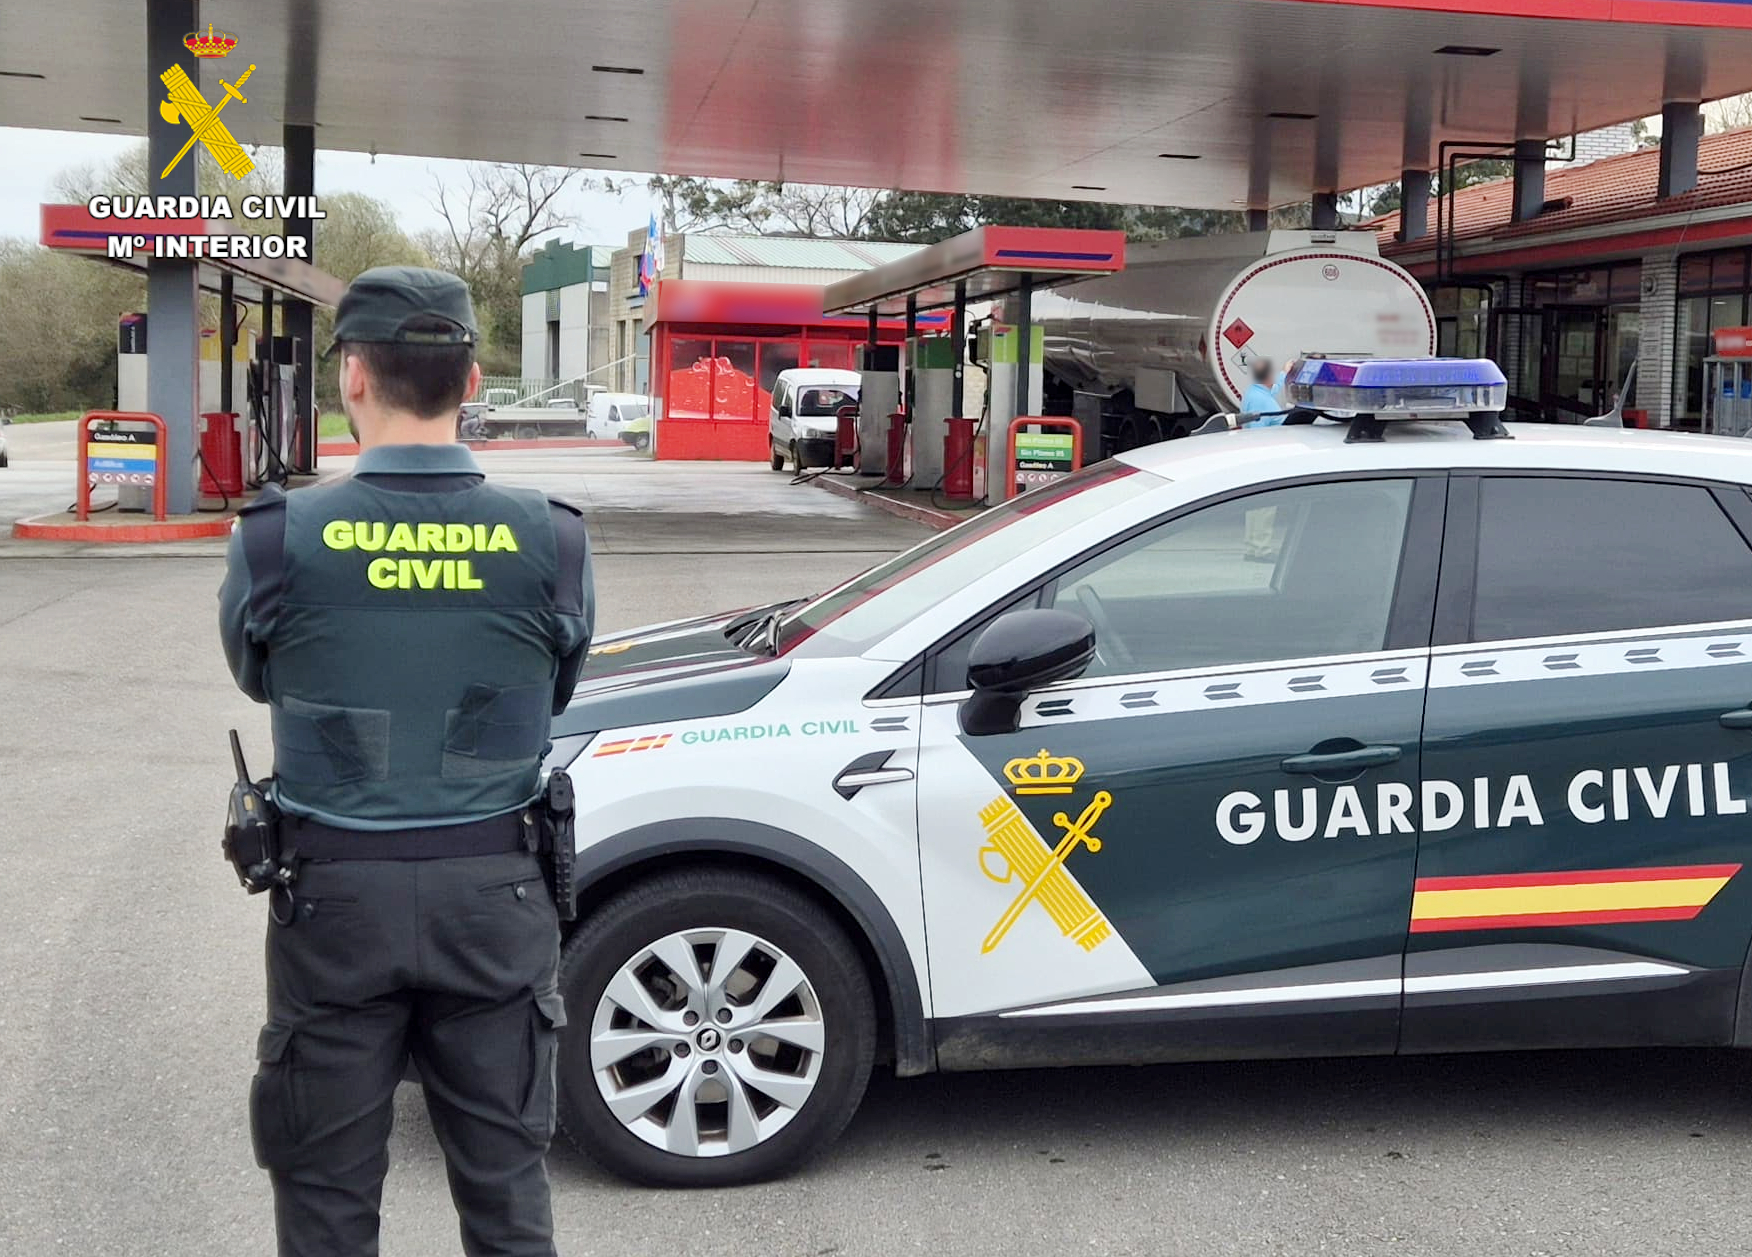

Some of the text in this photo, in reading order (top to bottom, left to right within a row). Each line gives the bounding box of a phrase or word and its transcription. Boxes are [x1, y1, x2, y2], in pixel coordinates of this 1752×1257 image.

[128, 434, 136, 442] A
[1047, 461, 1054, 469] A
[322, 519, 518, 552] GUARDIA
[367, 557, 483, 590] CIVIL
[681, 720, 860, 745] GUARDIA CIVIL
[1215, 761, 1748, 846] GUARDIA CIVIL
